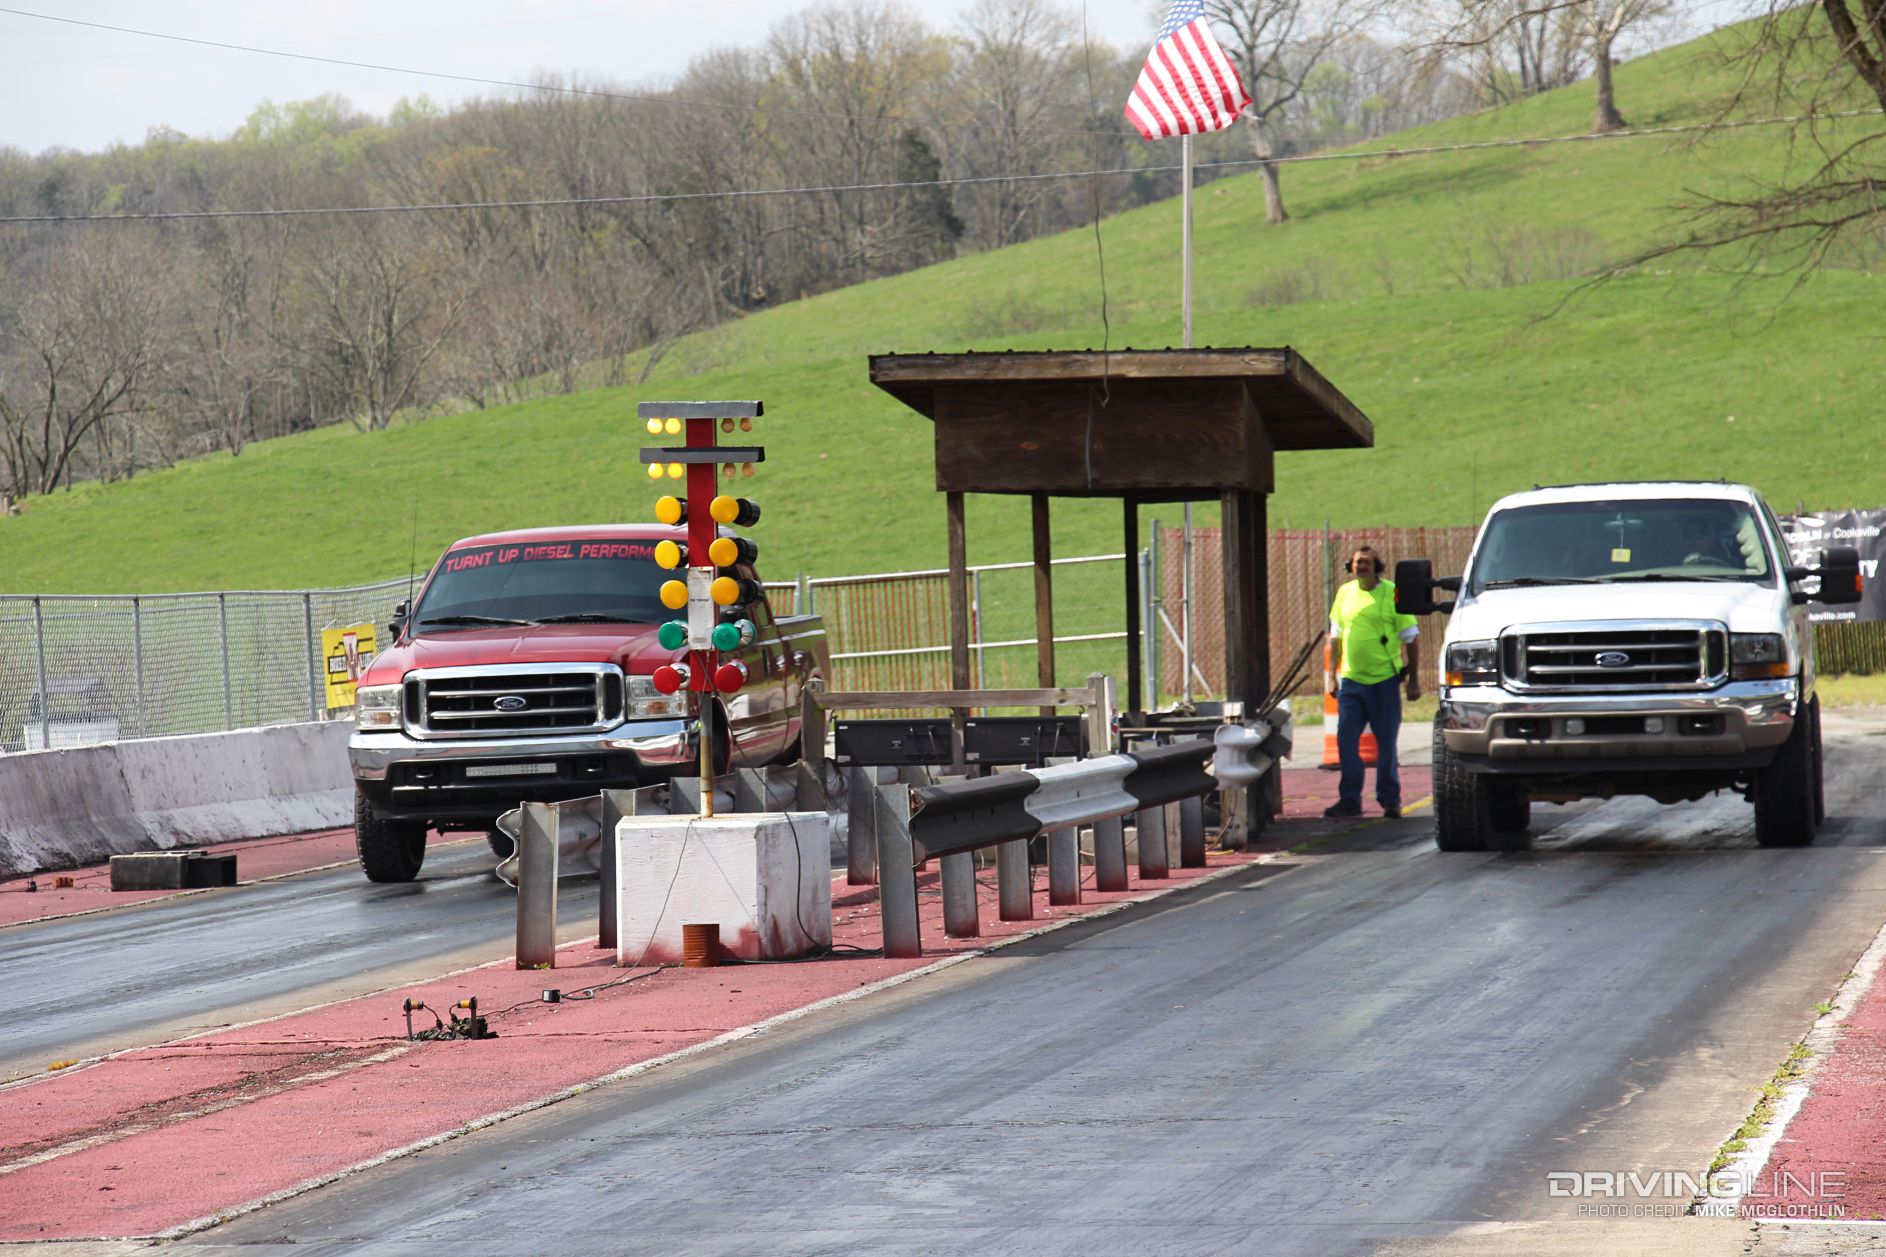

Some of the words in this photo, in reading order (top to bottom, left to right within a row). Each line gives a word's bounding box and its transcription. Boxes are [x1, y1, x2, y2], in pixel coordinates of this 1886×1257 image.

[1832, 526, 1880, 539] Cookeville
[446, 551, 494, 574] TURNT
[498, 548, 520, 563] UP
[523, 544, 575, 561] DIESEL
[579, 544, 655, 559] PERFORM
